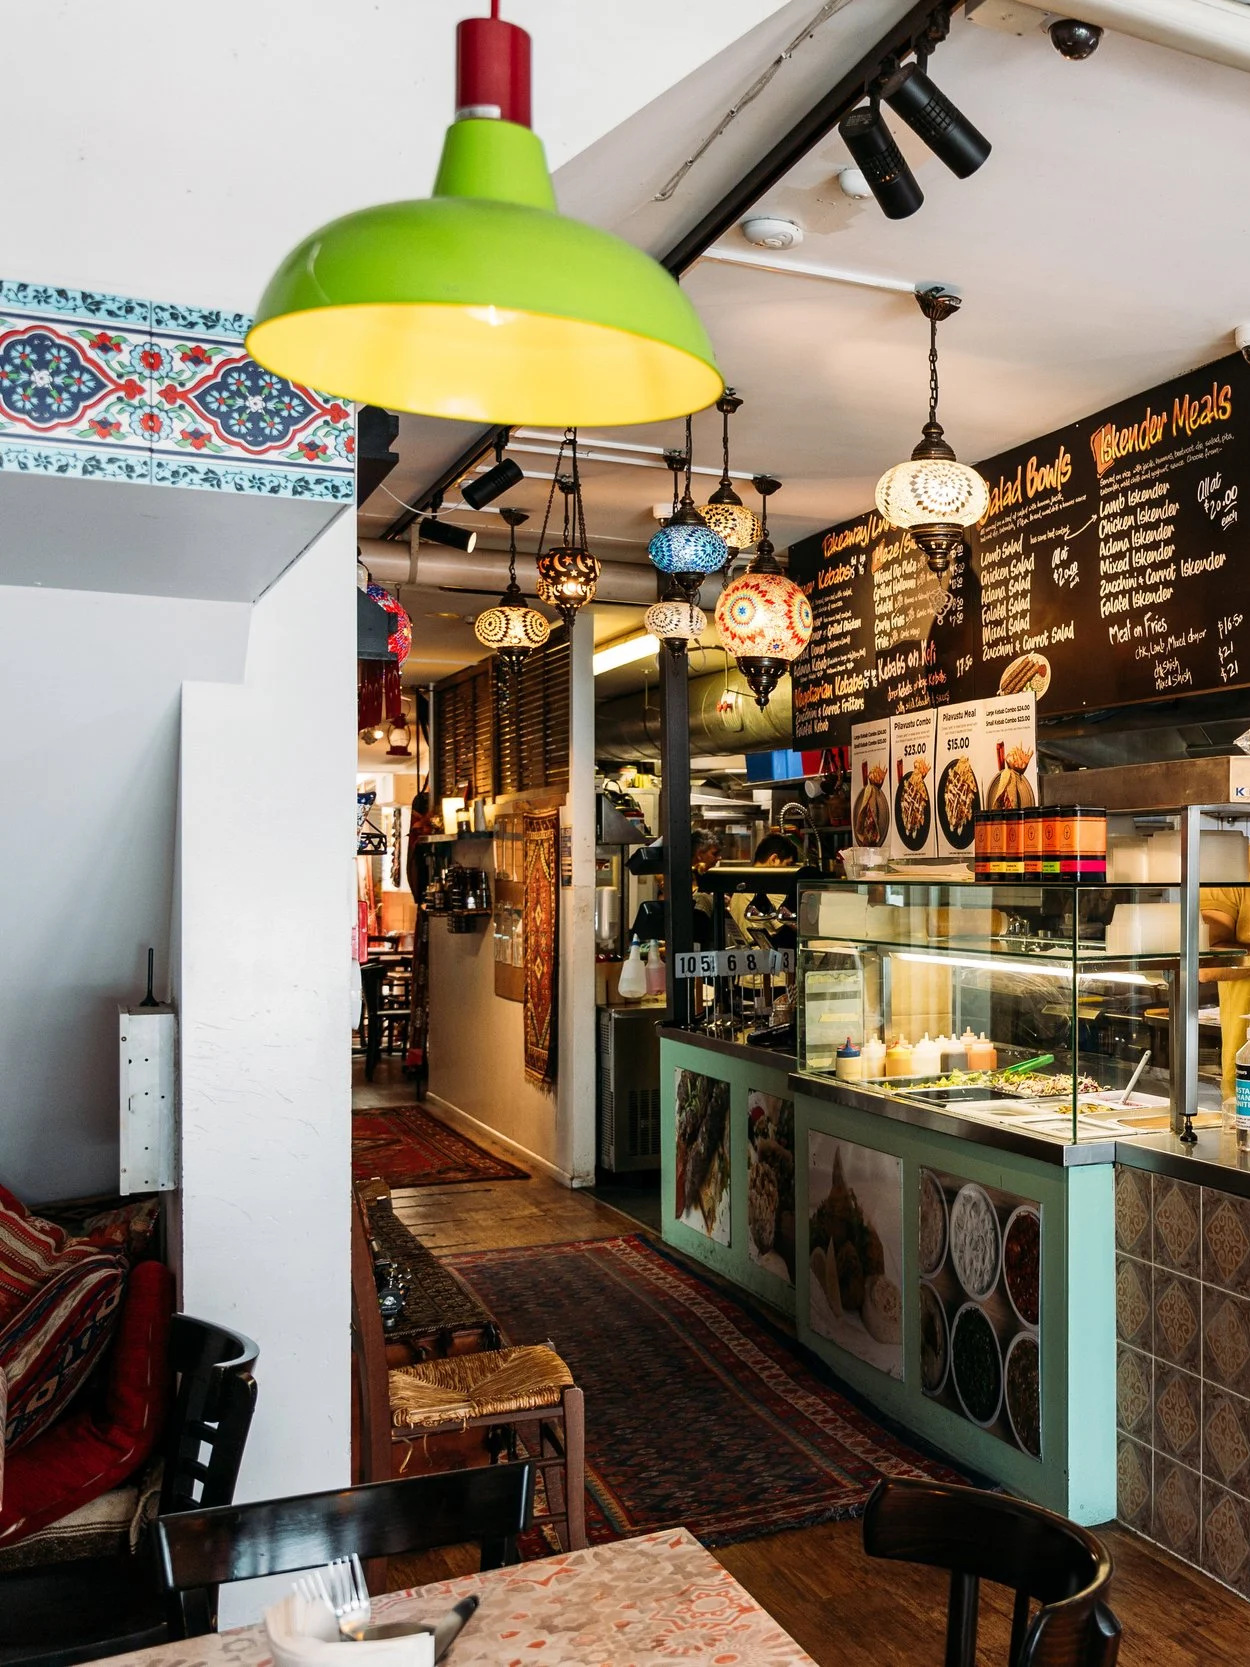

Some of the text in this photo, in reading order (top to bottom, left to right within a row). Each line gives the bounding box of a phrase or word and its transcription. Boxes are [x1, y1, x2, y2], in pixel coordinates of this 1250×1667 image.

[1100, 381, 1231, 464] Iskender Meals
[980, 465, 1023, 526] Salad
[1026, 445, 1072, 499] Bowls
[1100, 498, 1125, 518] Lamb
[1127, 481, 1170, 507] Iskender
[1099, 513, 1135, 538] Chicken
[1136, 500, 1180, 525] Iskender
[980, 533, 1024, 566] Lamb Salad
[1099, 523, 1176, 558] Adana Iskender
[980, 552, 1035, 586] Chicken Salad
[1100, 542, 1176, 576] Mixed Iskender
[818, 562, 850, 590] Kebabs
[1100, 552, 1227, 597] Zucchini Carrot Iskender
[980, 575, 1032, 605] Adana Salad
[1100, 587, 1174, 618] Falafel Iskender
[981, 596, 1031, 625] Falafel Salad
[981, 618, 1031, 646] Mixed Salad
[982, 620, 1075, 662] Zucchini Carrot Salad
[1108, 619, 1131, 645] Meat
[1143, 611, 1168, 638] Fries
[878, 652, 906, 682] Kebabs
[835, 673, 864, 696] Kebabs
[964, 708, 977, 719] Meal
[903, 742, 927, 757] $23.00
[946, 736, 970, 751] $15.00
[1235, 787, 1245, 796] K
[680, 956, 697, 974] 10
[727, 954, 737, 972] 6
[746, 954, 757, 971] 8
